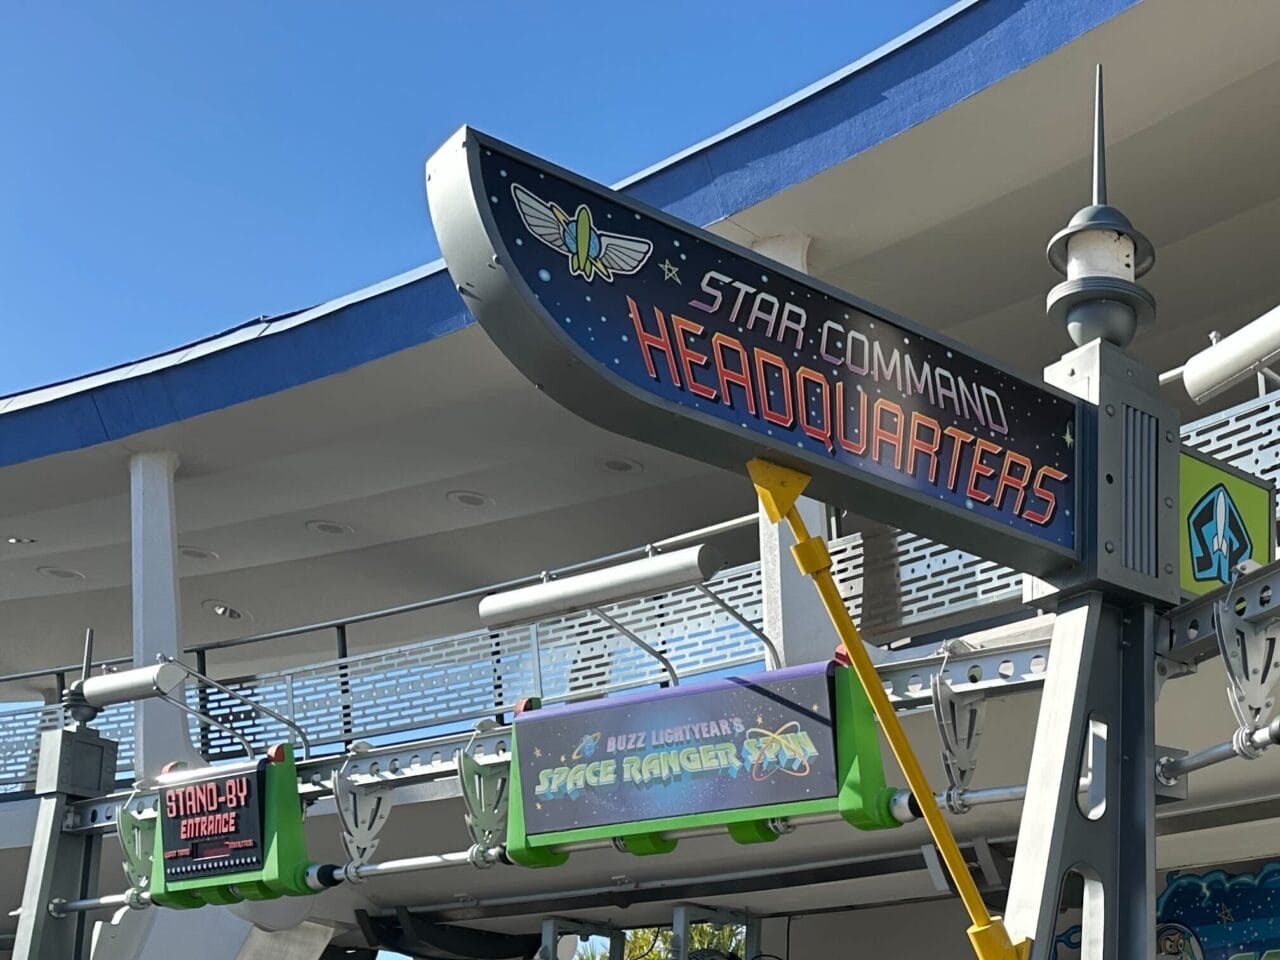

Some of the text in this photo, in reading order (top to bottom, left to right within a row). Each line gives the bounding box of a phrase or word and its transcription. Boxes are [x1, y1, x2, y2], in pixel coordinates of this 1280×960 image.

[689, 270, 1009, 436] STAR COMMAND
[627, 295, 1068, 526] HEADQUARTERS
[606, 717, 746, 753] BUZZ LIGHTYEAR'S
[534, 730, 820, 798] SPACE RANGER SPIN
[166, 777, 248, 818] STAND-BY
[180, 812, 236, 840] ENTRANCE
